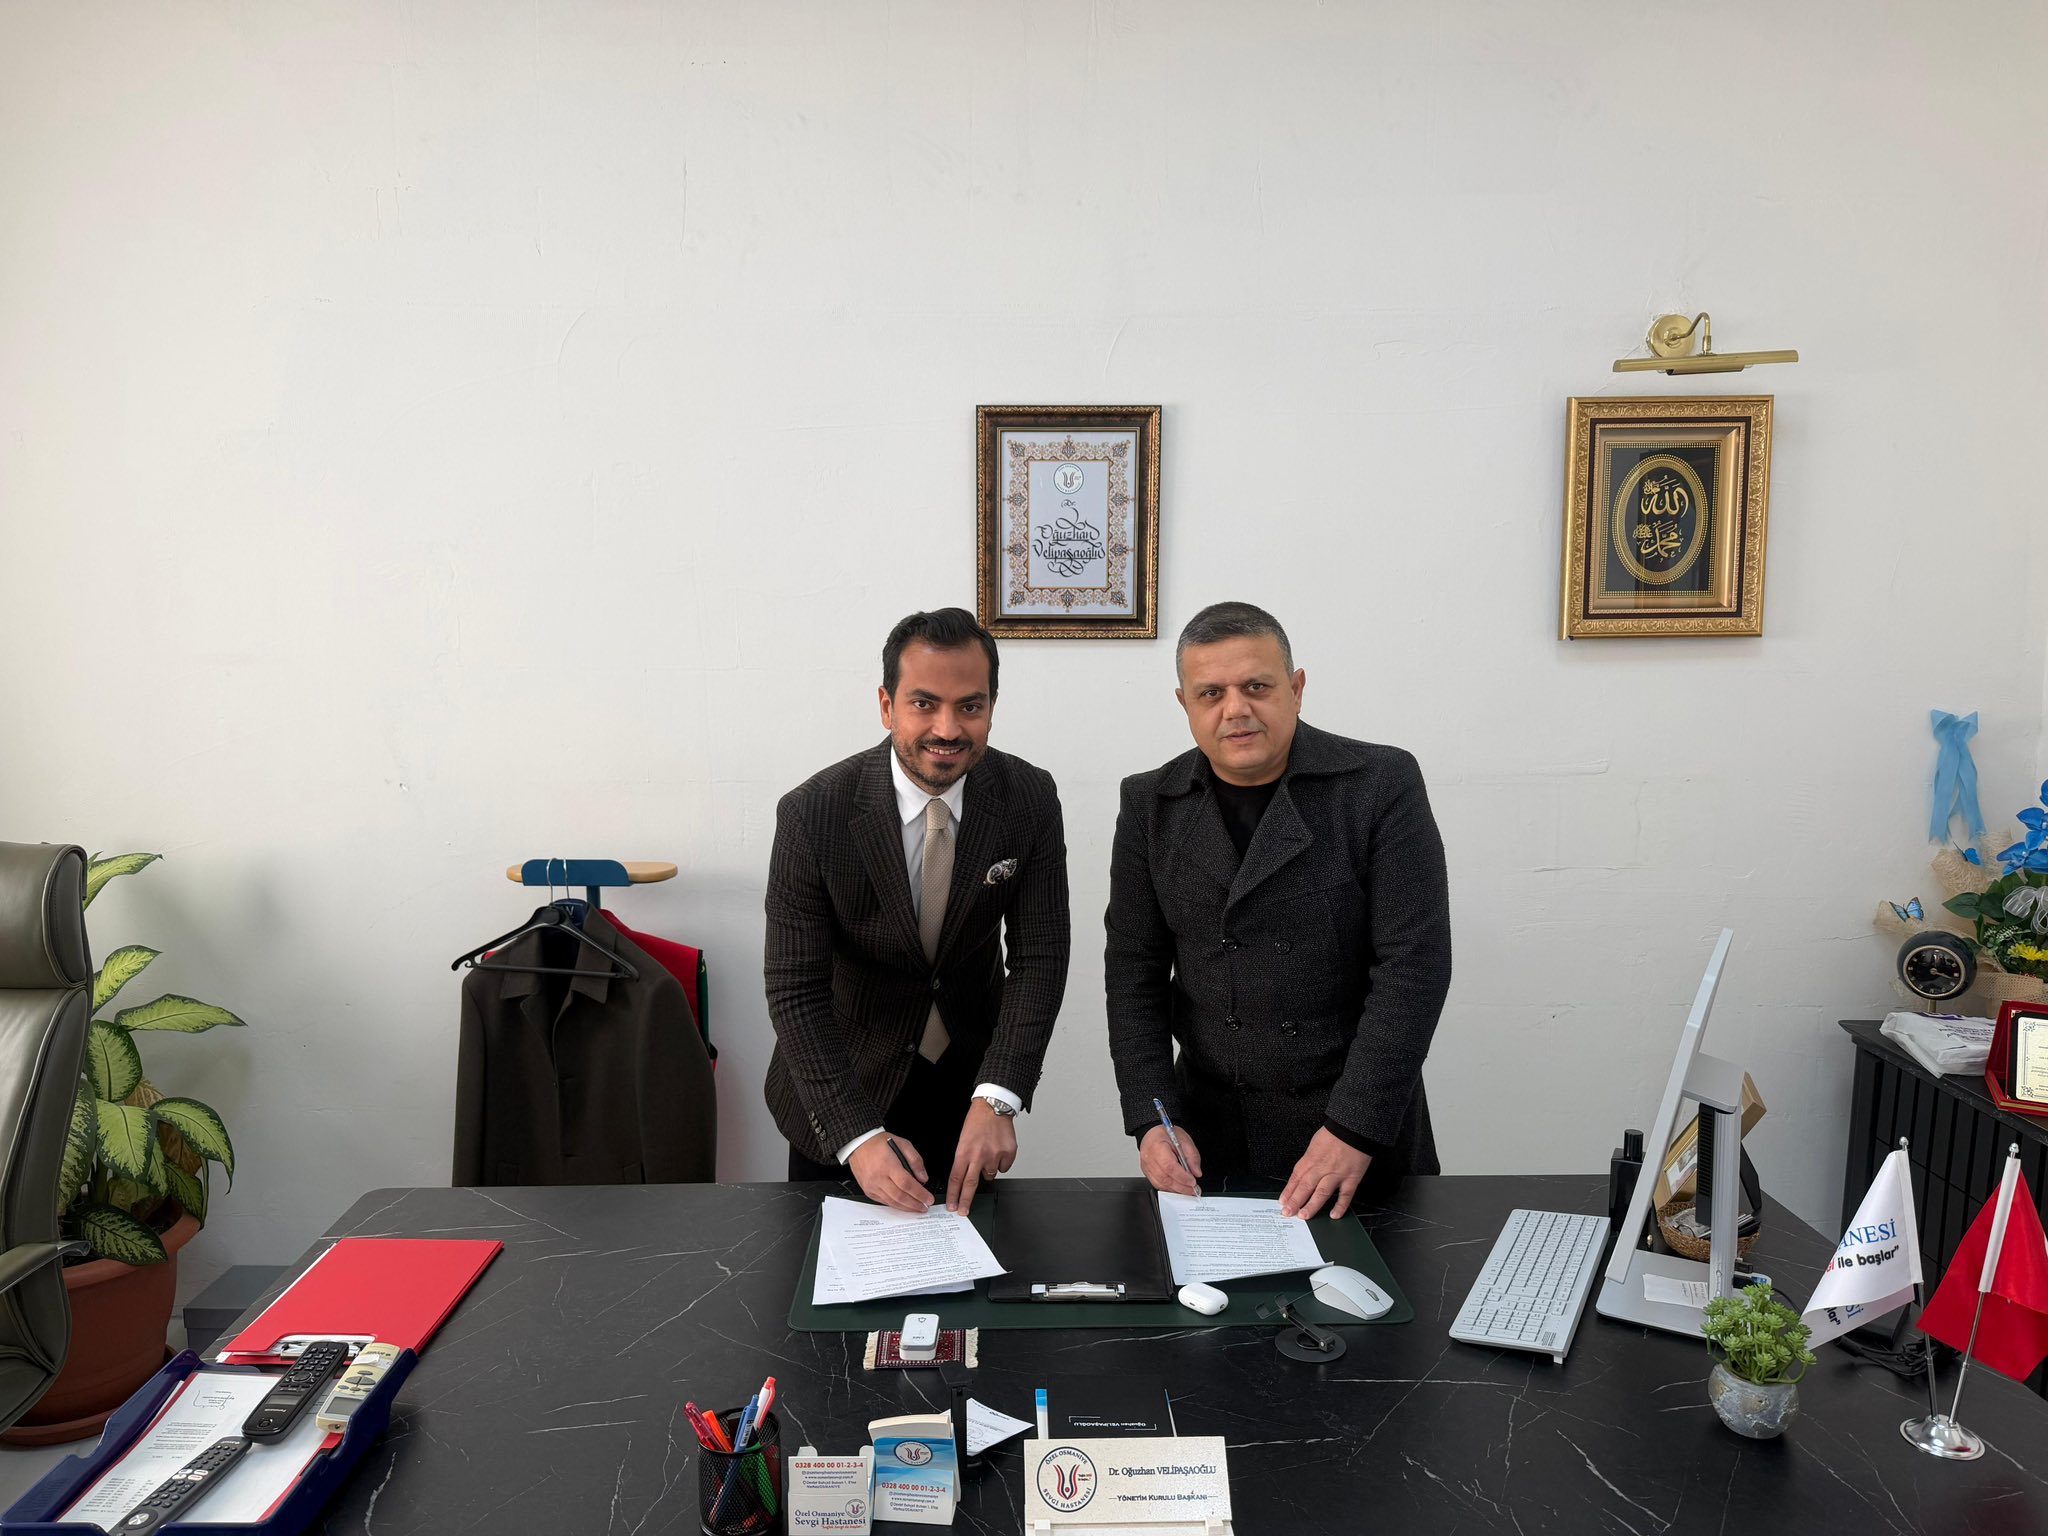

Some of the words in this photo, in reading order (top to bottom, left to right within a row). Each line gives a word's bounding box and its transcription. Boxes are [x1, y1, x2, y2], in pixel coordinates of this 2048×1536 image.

[1837, 1256, 1853, 1269] ile
[1109, 1467, 1120, 1476] Dr.
[1121, 1466, 1156, 1477] Oğuzhan
[1157, 1464, 1217, 1476] VELİPAŞAOĞLU
[811, 1510, 846, 1519] Osmaniye
[795, 1516, 820, 1528] Sevgi
[821, 1516, 866, 1526] Hastanesi
